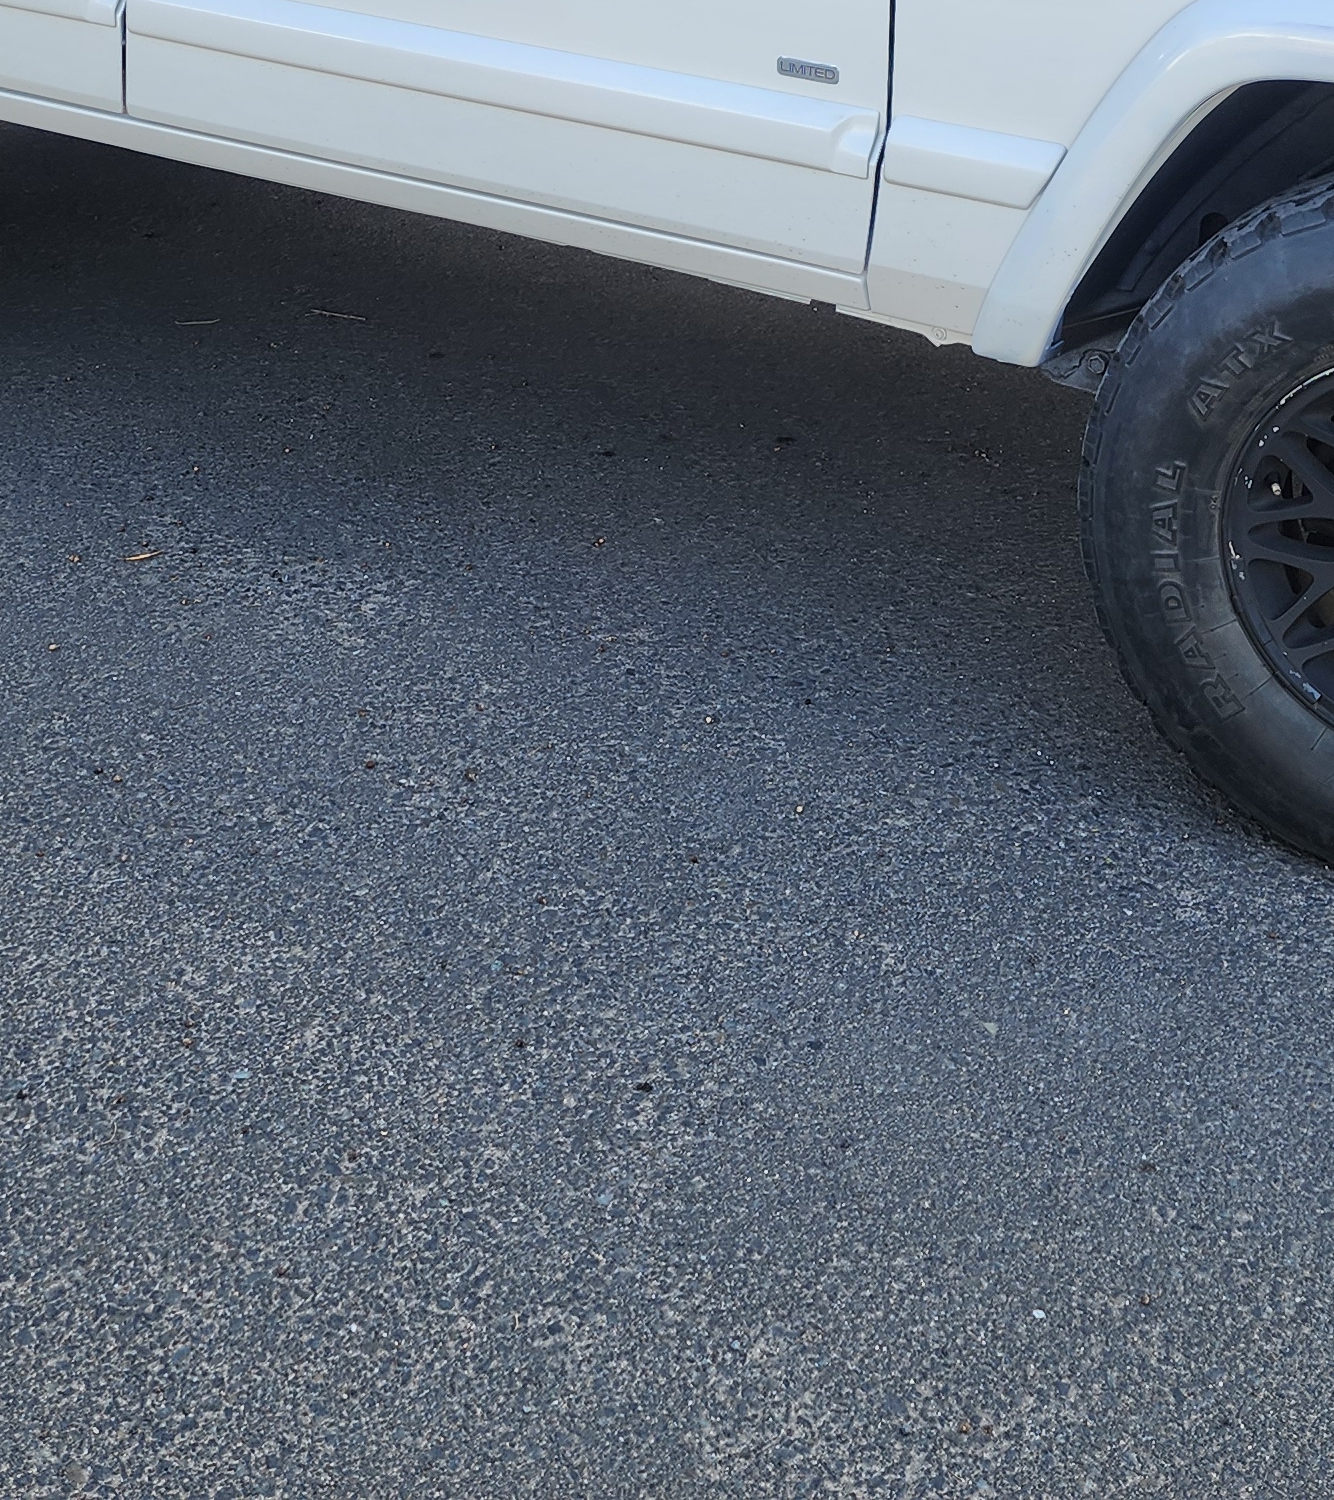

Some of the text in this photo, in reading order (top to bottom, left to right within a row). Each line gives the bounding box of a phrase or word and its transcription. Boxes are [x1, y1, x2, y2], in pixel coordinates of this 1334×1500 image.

[780, 60, 836, 80] LIMITED
[1149, 316, 1294, 722] RADIAL ATX
